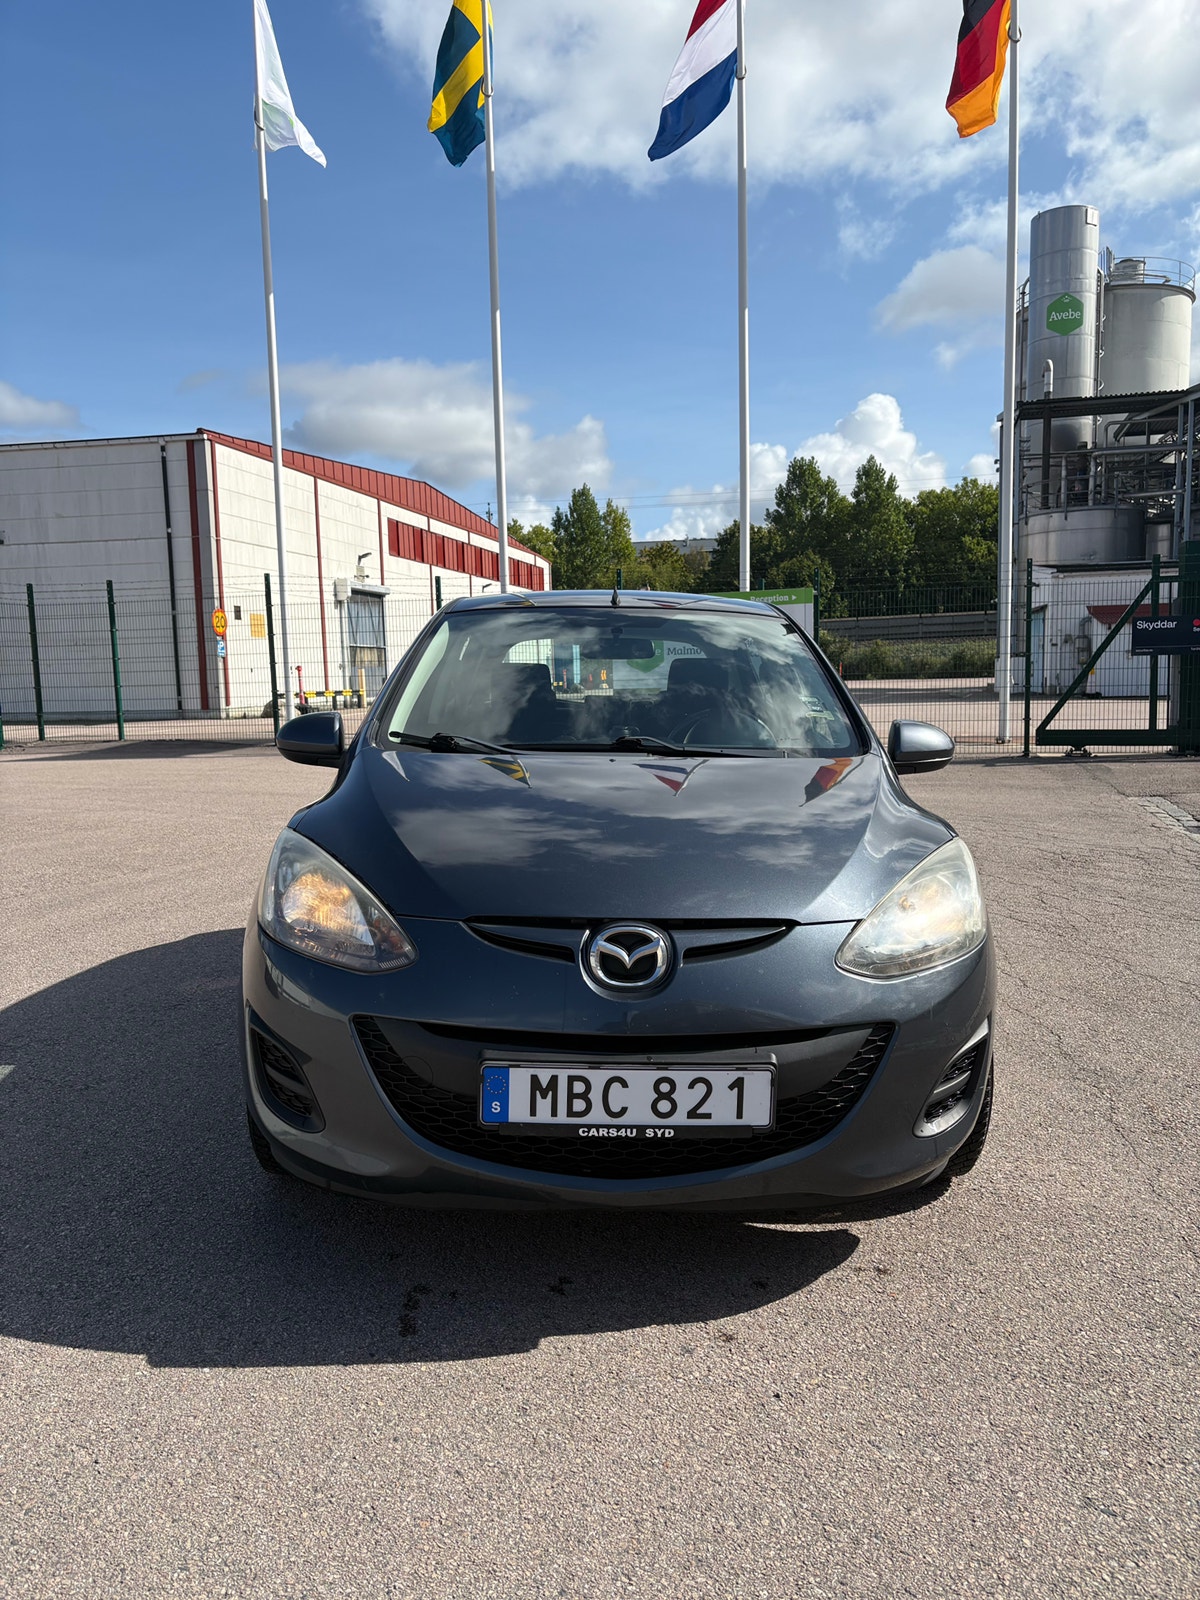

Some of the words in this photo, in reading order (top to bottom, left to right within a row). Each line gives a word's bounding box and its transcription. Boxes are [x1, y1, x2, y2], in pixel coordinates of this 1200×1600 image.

[1049, 308, 1081, 322] Avebe
[215, 615, 226, 629] 20
[1136, 620, 1178, 631] Skyddar
[529, 1074, 629, 1119] MBC
[650, 1076, 745, 1120] 821
[491, 1101, 501, 1113] S
[578, 1127, 637, 1137] CARS4U
[645, 1128, 675, 1138] SYD
